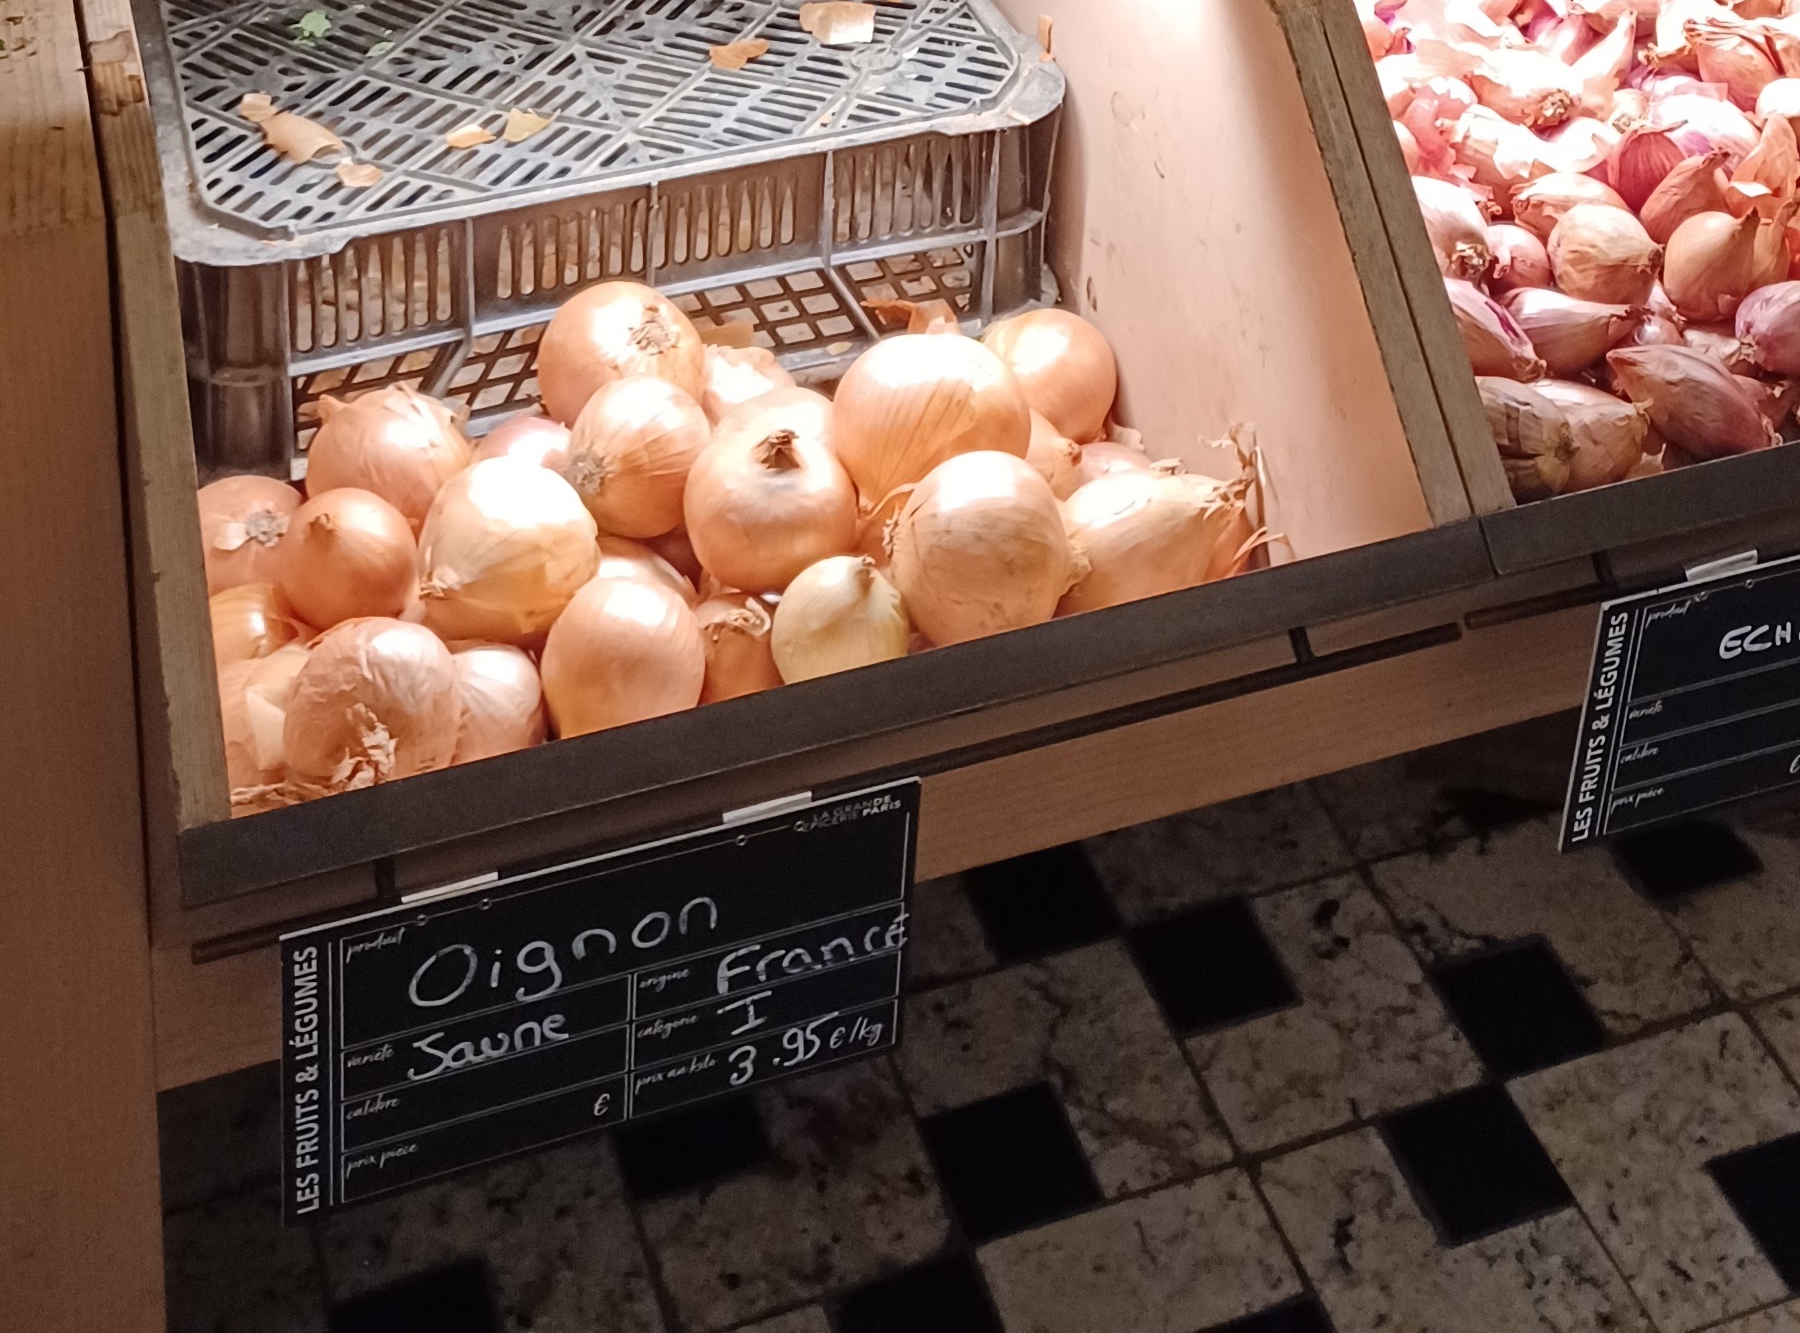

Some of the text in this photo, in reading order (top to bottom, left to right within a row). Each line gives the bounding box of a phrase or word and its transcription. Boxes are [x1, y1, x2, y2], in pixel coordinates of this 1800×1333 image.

[1718, 621, 1800, 660] ECH
[1572, 611, 1629, 843] LES FRUITS & LÉGUMES
[803, 799, 902, 832] PICERIE PARIS
[346, 926, 405, 965] produit
[408, 895, 718, 1007] Oignon
[638, 967, 691, 992] origine
[289, 945, 320, 1215] LES FRUITS & LÉGUMES
[592, 1093, 611, 1117] €
